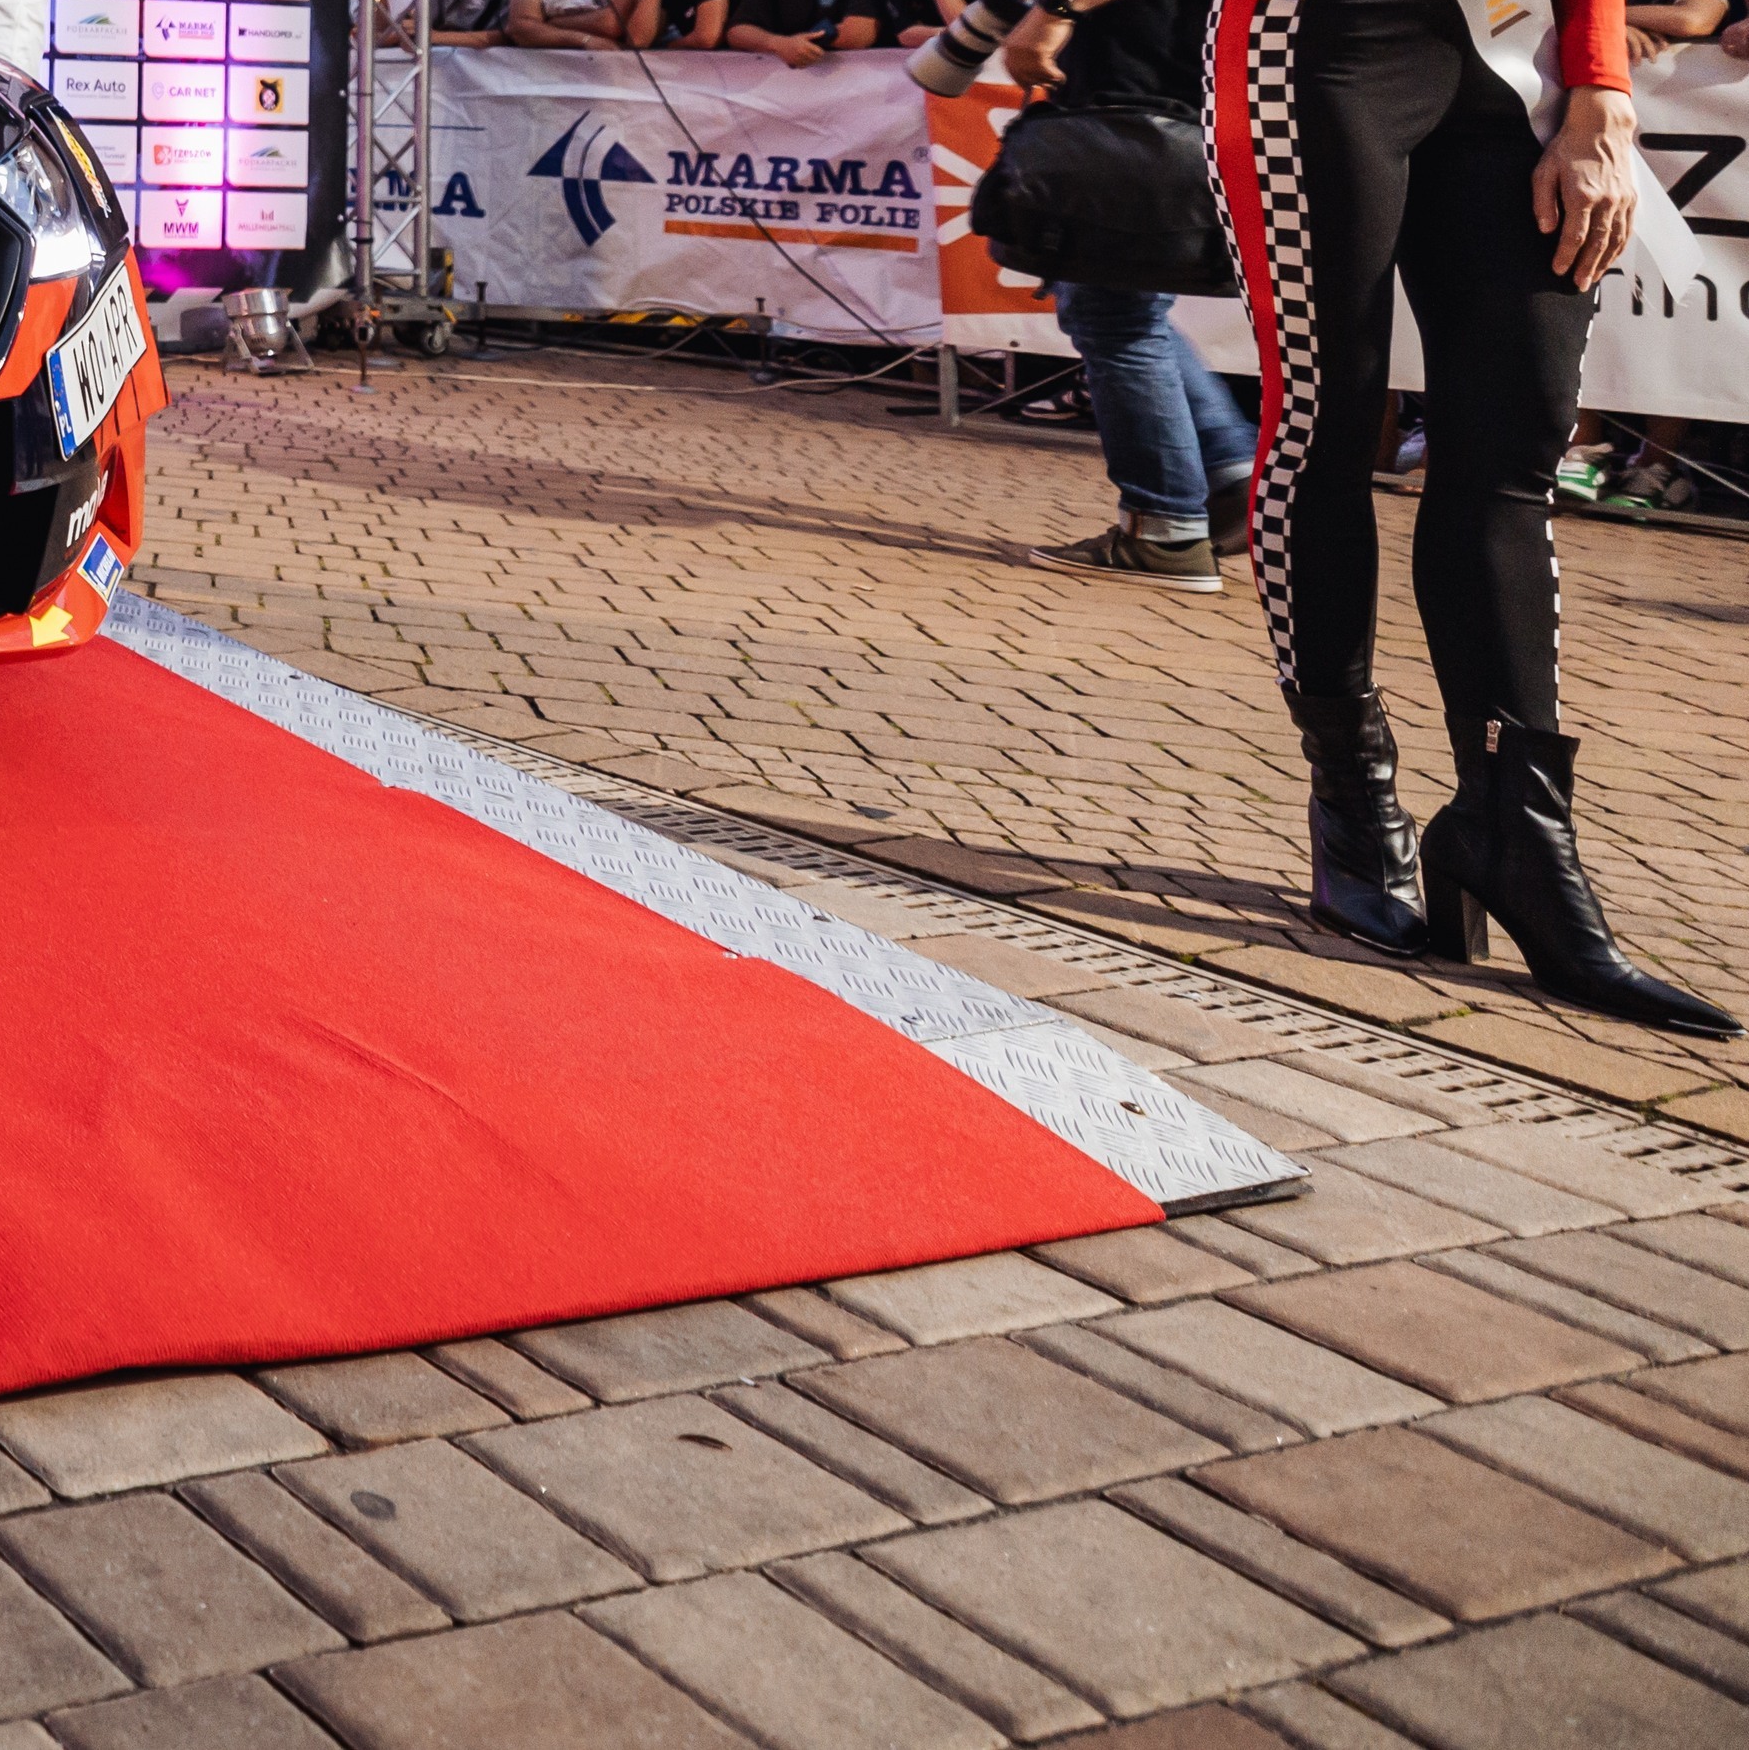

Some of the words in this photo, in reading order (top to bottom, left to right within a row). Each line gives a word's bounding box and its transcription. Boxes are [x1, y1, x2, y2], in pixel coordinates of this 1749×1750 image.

[66, 77, 90, 92] Rex
[94, 78, 127, 93] Auto
[169, 86, 192, 98] CAR
[195, 87, 216, 98] NET
[666, 150, 923, 201] MARMA
[664, 192, 801, 222] POLSKIE
[815, 201, 920, 230] FOLIE
[163, 221, 200, 234] MWM
[57, 411, 72, 439] PL
